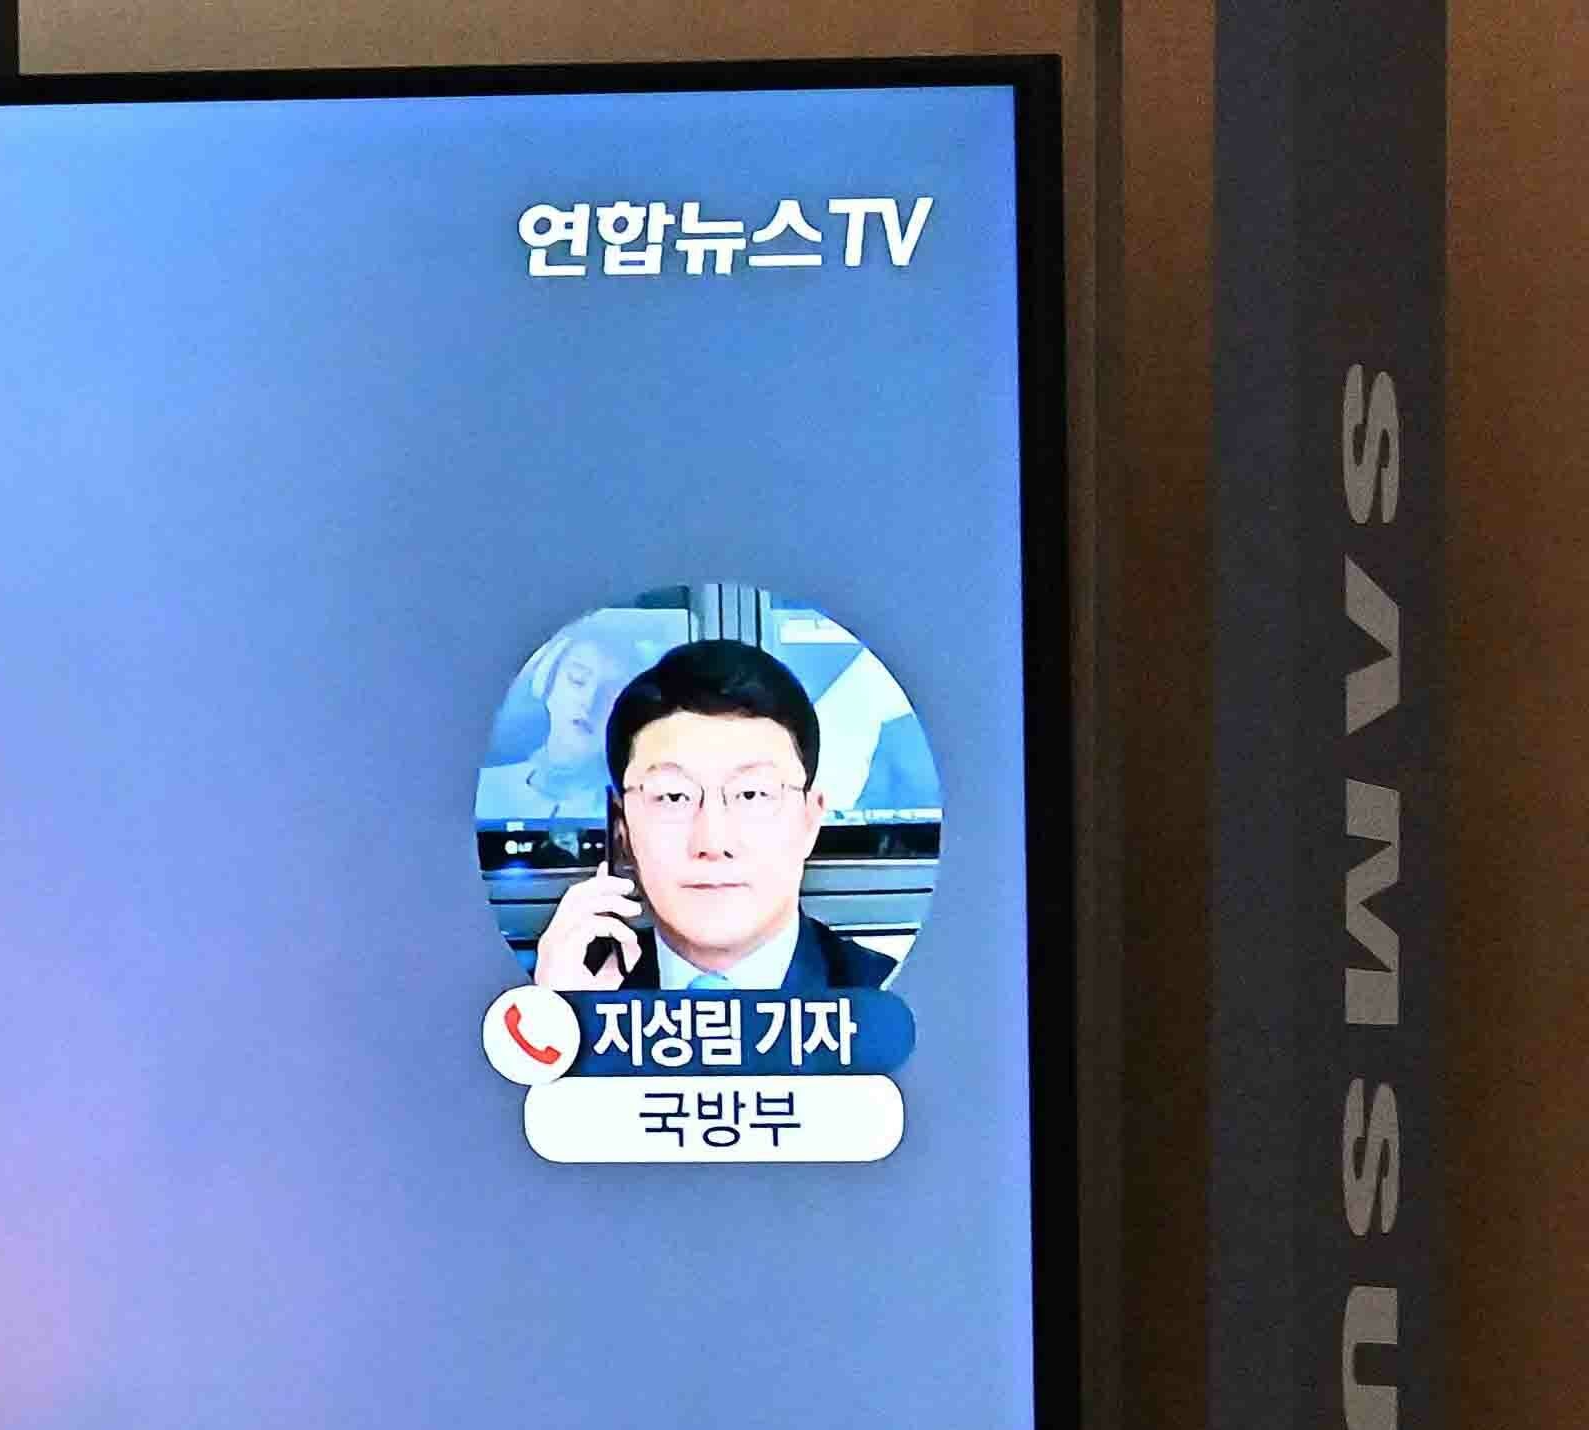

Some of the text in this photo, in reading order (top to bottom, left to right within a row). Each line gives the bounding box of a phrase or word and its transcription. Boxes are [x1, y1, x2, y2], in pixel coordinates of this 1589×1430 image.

[518, 197, 934, 277] 연합뉴스TV
[593, 998, 857, 1067] 지성림 기자
[638, 1090, 802, 1148] 국방부
